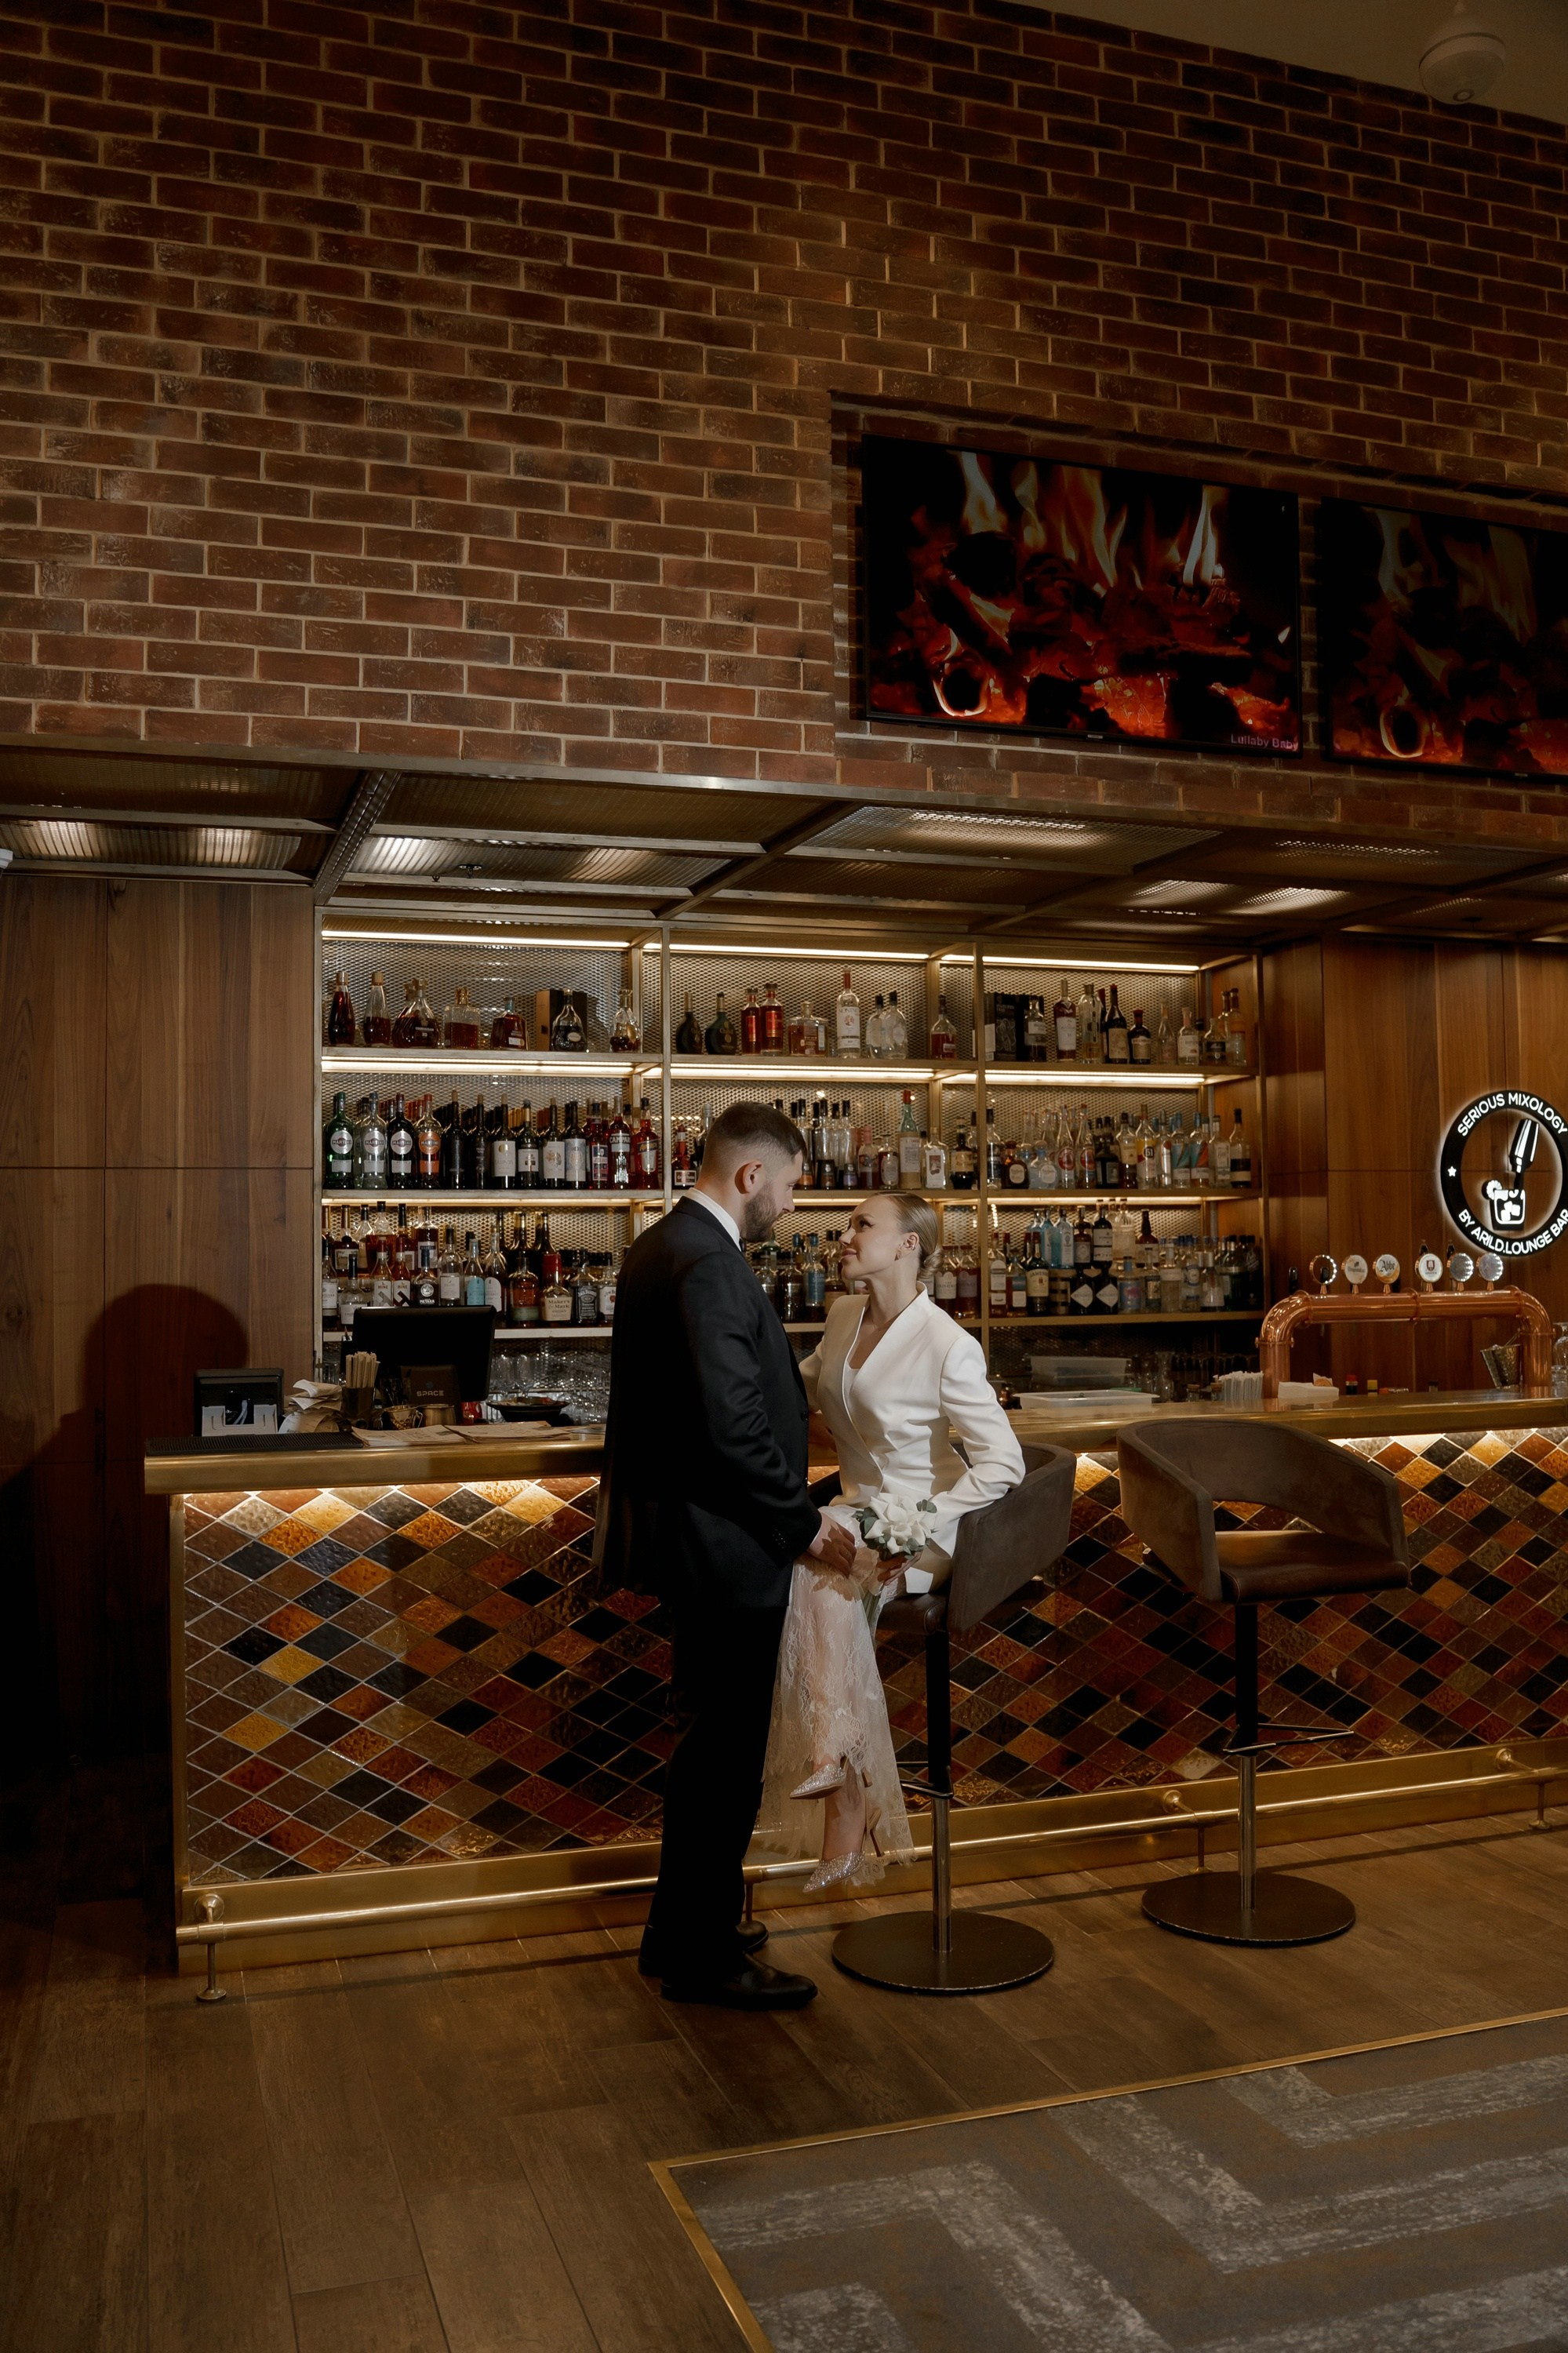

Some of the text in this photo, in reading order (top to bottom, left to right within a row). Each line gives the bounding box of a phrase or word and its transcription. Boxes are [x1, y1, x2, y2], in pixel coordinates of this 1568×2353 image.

[1231, 733, 1299, 751] Lullaby Baby
[1457, 1093, 1568, 1136] SERIOUS MIXOLOGY
[1458, 1209, 1475, 1227] BY
[1550, 1209, 1568, 1237] BAR
